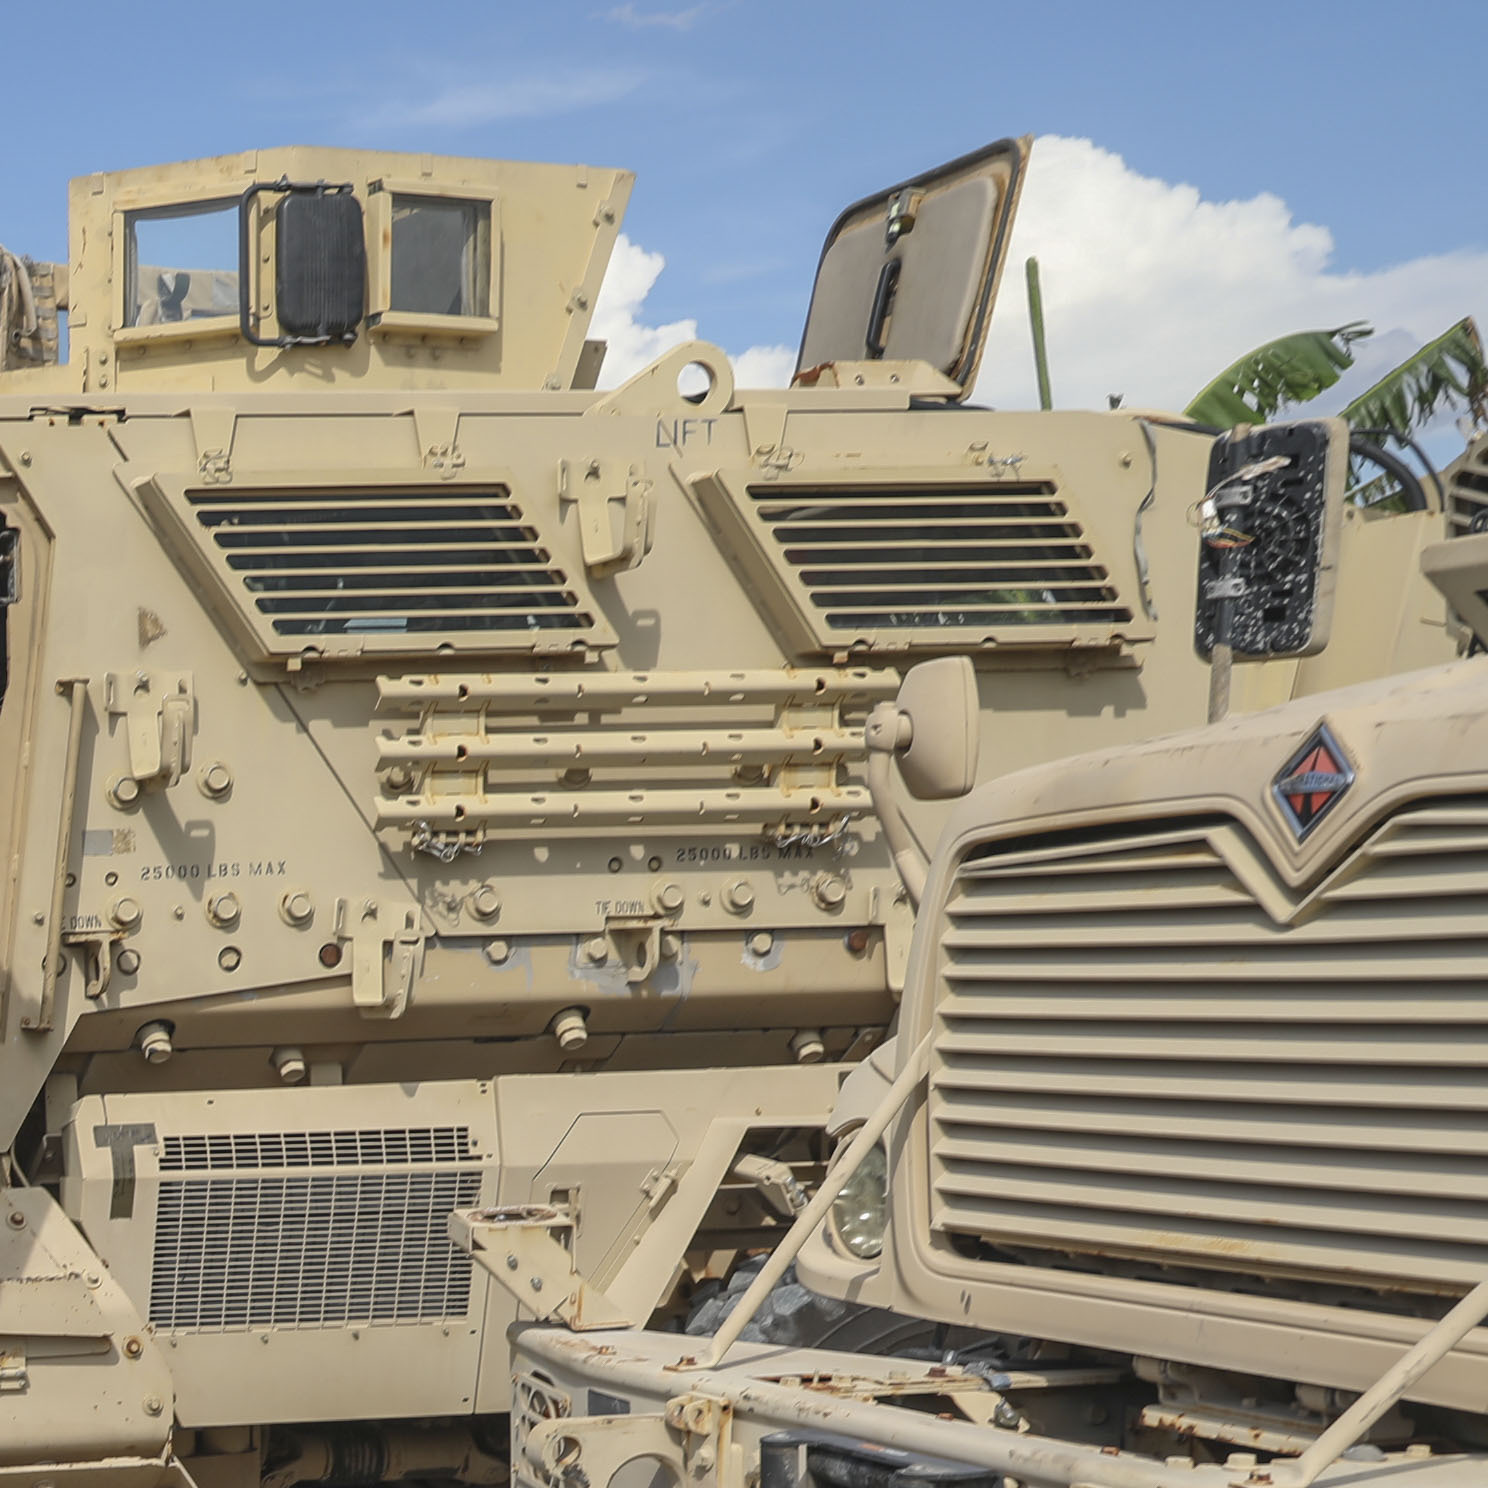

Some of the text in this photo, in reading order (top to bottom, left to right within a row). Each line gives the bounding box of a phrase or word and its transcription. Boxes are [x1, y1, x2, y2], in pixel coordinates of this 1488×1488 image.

[676, 846, 731, 863] 25000
[739, 846, 771, 861] LBS
[140, 860, 288, 881] 25000 LBS MAX
[615, 899, 644, 915] DOWN
